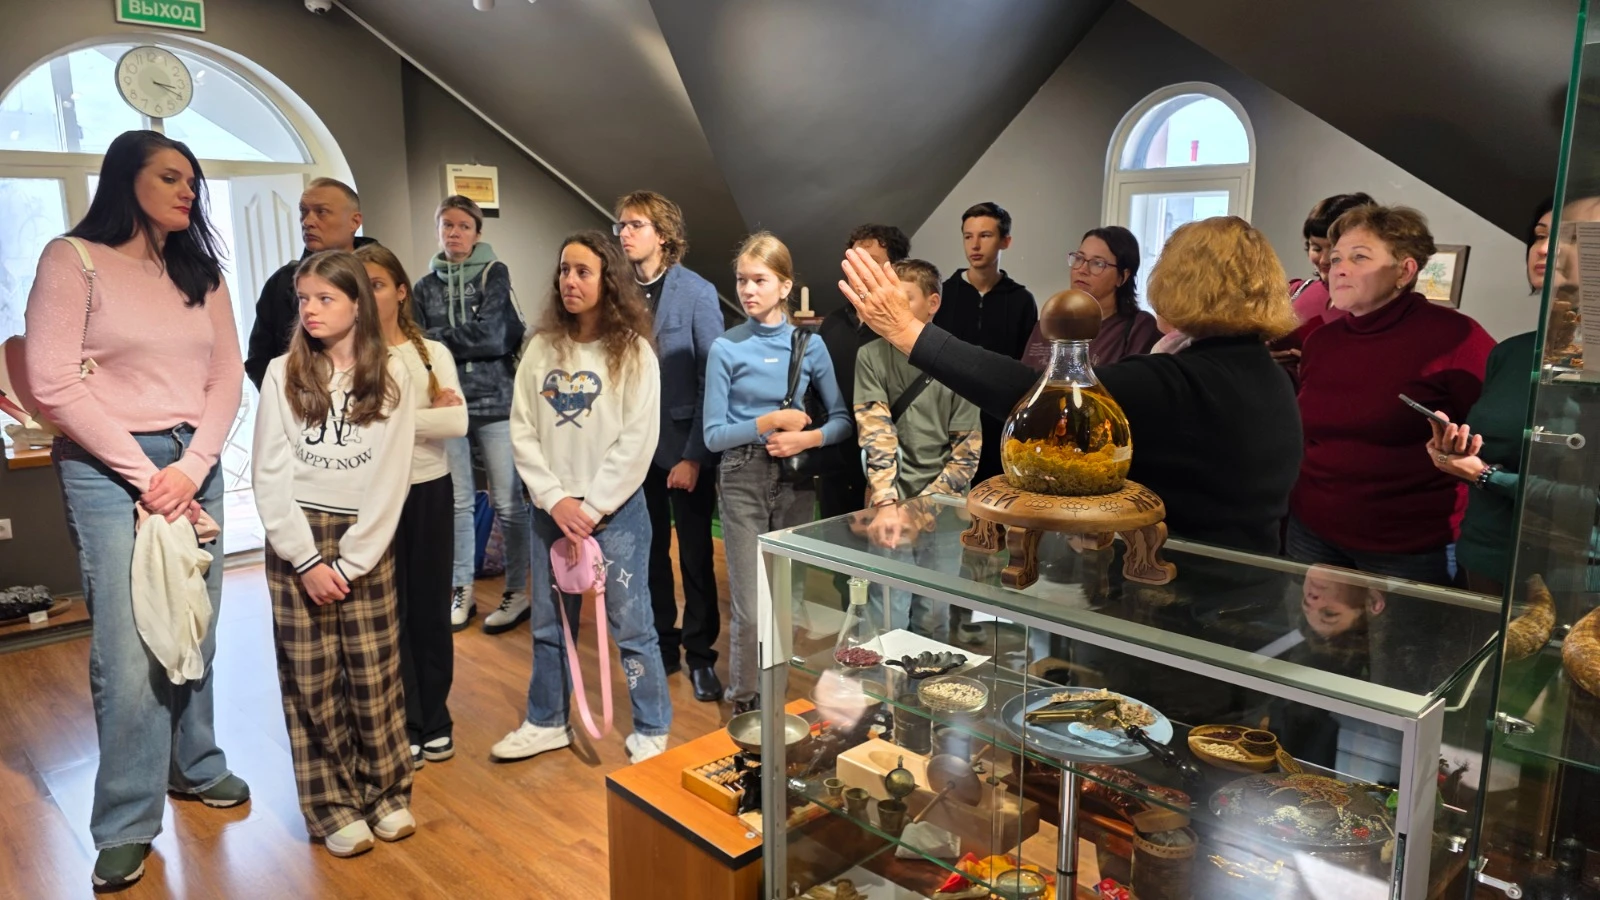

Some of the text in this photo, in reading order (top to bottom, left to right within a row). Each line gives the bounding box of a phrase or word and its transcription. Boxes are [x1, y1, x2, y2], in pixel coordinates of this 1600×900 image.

[128, 0, 196, 23] ВЫХОД
[134, 53, 143, 65] 11
[147, 52, 156, 63] 12
[124, 61, 138, 75] 10
[172, 65, 180, 77] 2
[123, 75, 132, 86] 9
[177, 78, 185, 90] 3
[130, 89, 138, 100] 8
[141, 98, 149, 109] 7
[154, 103, 163, 114] 6
[167, 100, 176, 111] 5
[570, 384, 584, 393] FOR
[336, 447, 373, 470] NOW
